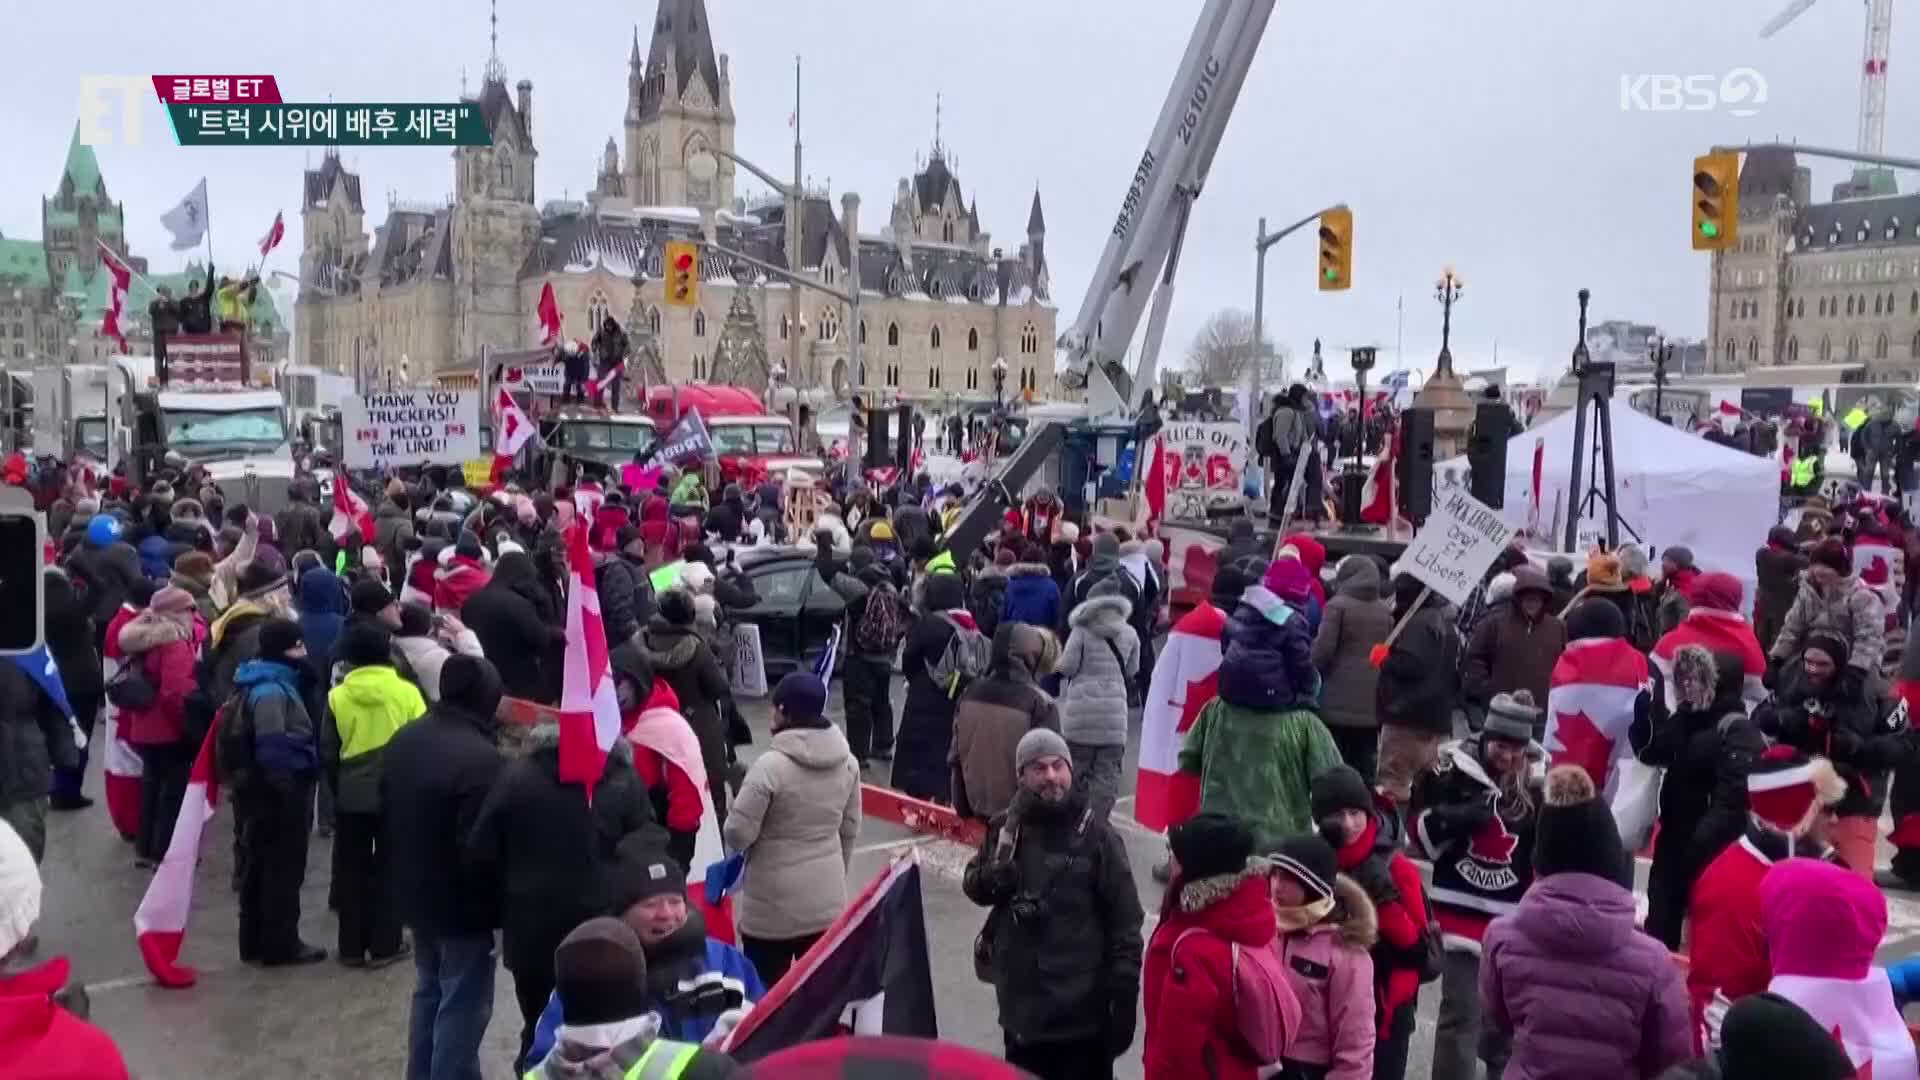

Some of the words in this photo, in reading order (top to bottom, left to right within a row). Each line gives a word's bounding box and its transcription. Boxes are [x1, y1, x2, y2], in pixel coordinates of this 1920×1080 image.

[1177, 55, 1219, 145] 26101C
[364, 393, 415, 409] THANK
[427, 392, 460, 406] YOU
[368, 407, 456, 424] TRUCKERS!!
[390, 424, 433, 441] HOLD
[371, 442, 398, 456] THE
[406, 439, 447, 454] LINE!!
[1458, 860, 1516, 889] CANADA
